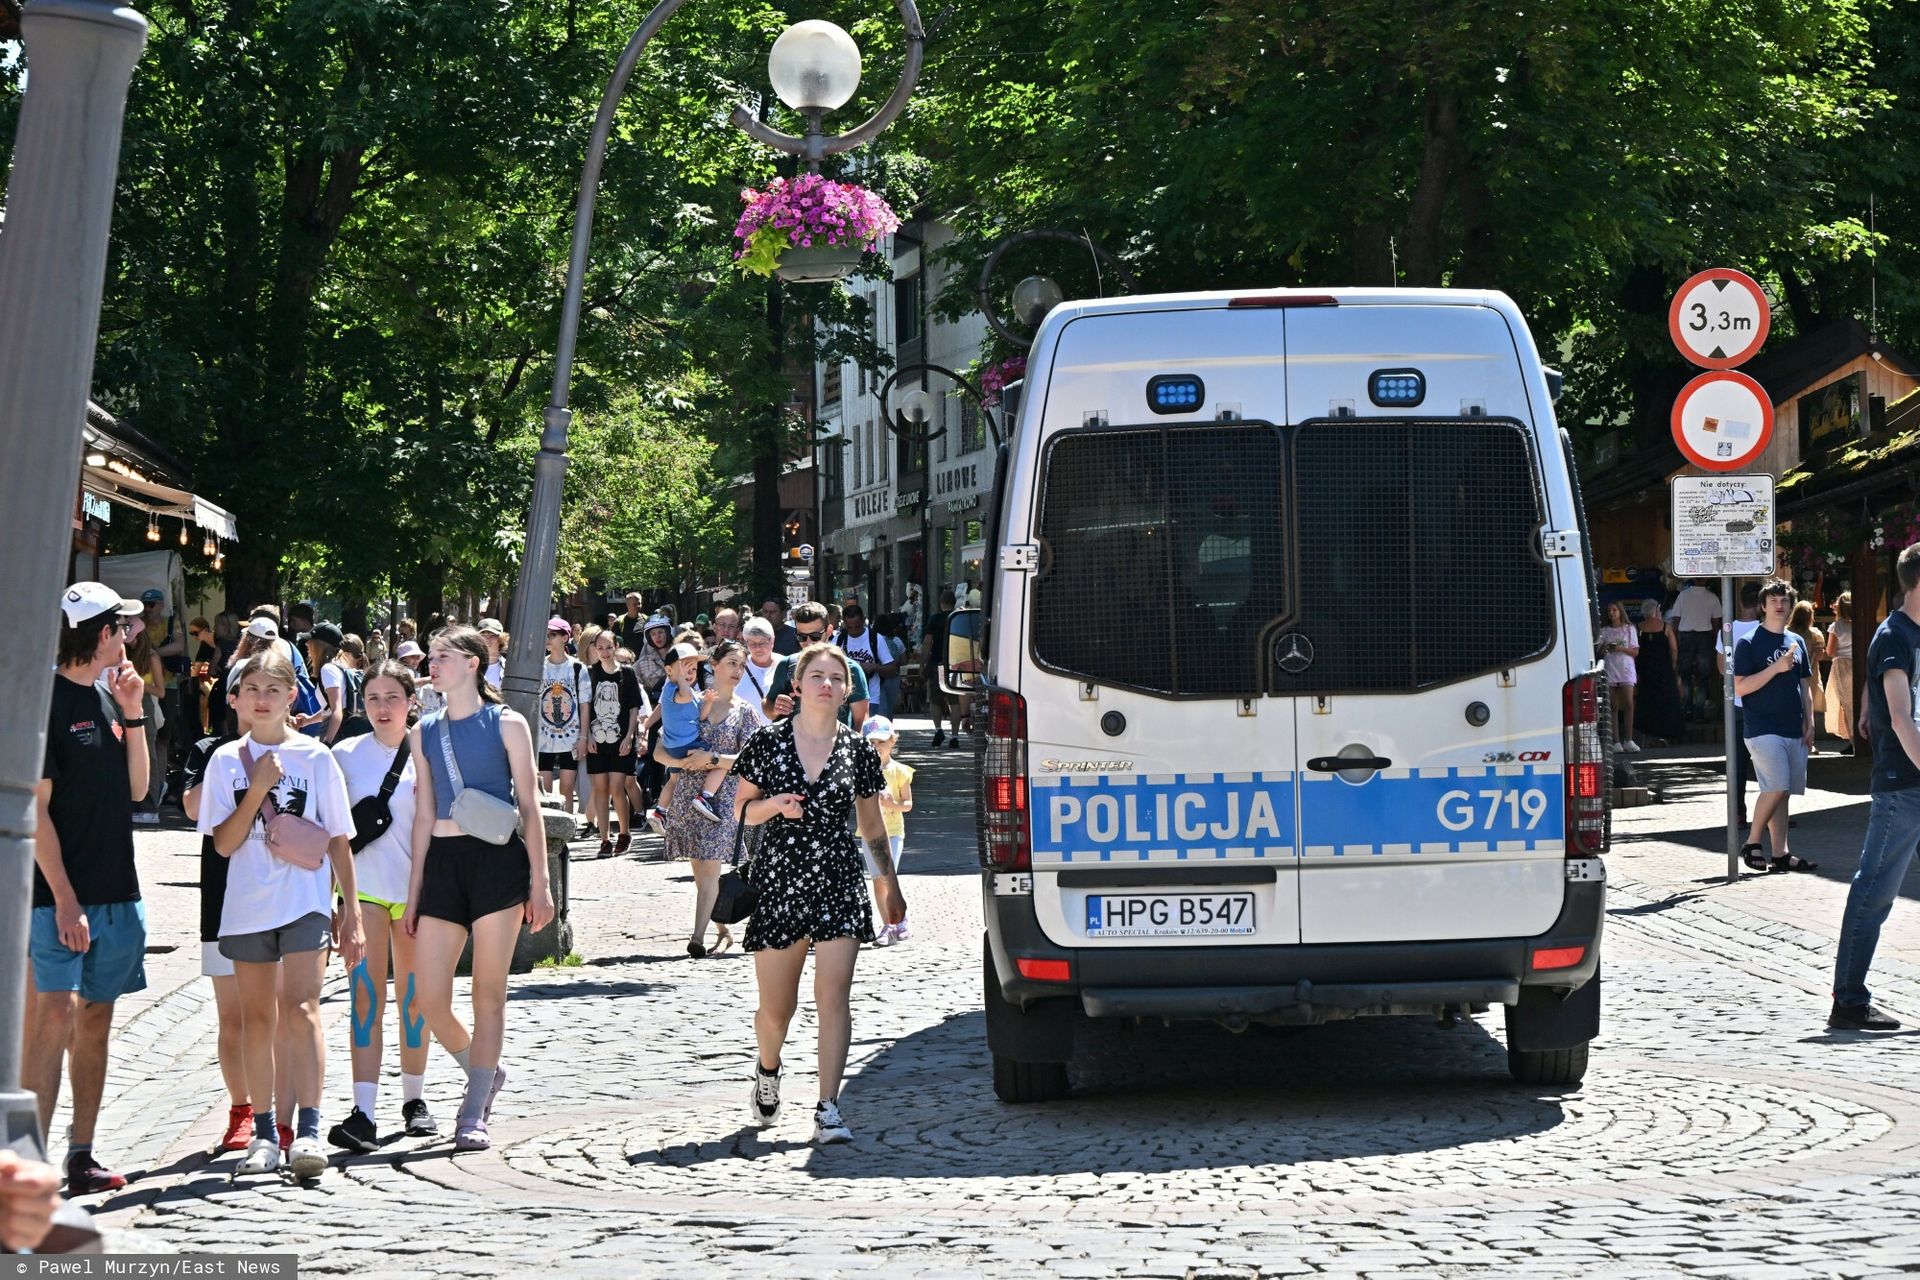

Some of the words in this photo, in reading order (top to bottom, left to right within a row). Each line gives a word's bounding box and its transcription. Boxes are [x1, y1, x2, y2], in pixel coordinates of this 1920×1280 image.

[855, 490, 888, 519] KOLEJE
[936, 464, 977, 494] LINOWE
[440, 734, 457, 782] lululemon
[1518, 751, 1551, 762] CDI
[232, 775, 308, 791] CARNIA
[1050, 791, 1280, 843] POLICJA
[1090, 917, 1100, 925] PL
[1106, 899, 1169, 927] HPG
[1179, 898, 1248, 925] B547
